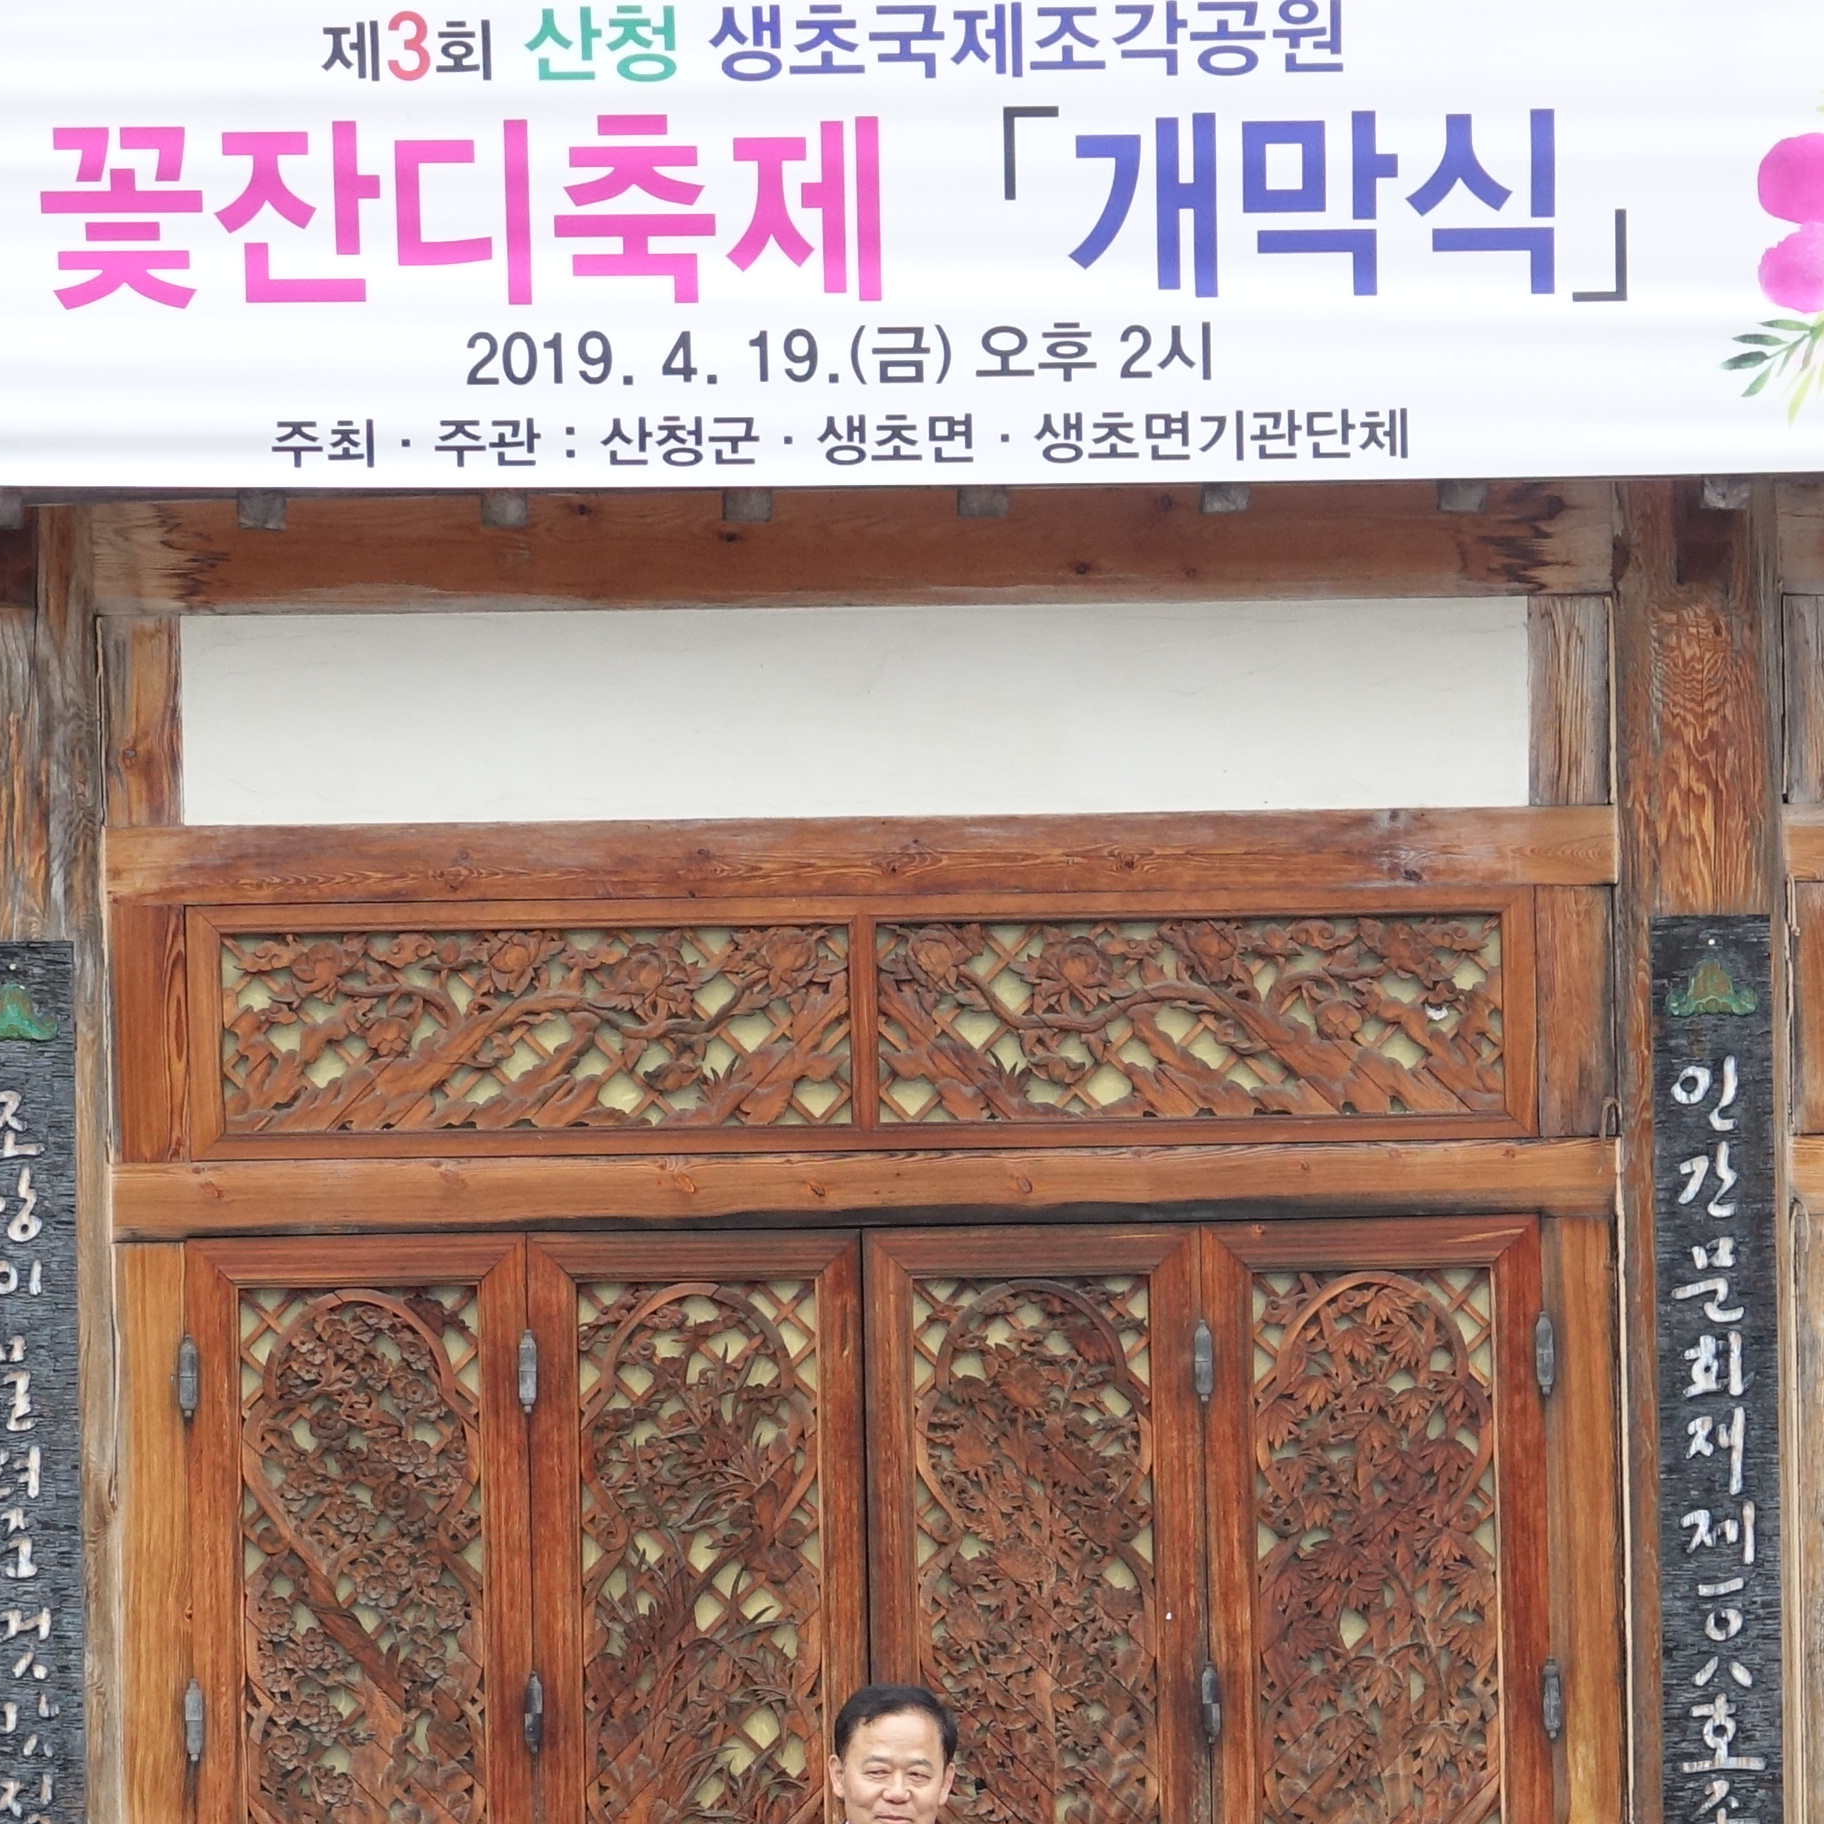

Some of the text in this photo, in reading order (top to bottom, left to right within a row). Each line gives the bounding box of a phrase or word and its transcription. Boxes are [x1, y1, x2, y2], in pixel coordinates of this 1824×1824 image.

[322, 0, 1344, 83] 제3회 산청 생초국제조각공원
[39, 113, 883, 311] 꽃잔디축제
[466, 330, 634, 386] 2019.
[661, 330, 718, 385] 4.
[975, 321, 1098, 383] 오후
[1119, 320, 1212, 381] 2시
[271, 418, 375, 469] 주최
[434, 417, 542, 468] 주관
[599, 415, 760, 468] 산청군
[816, 412, 974, 466] 생초면
[1033, 407, 1409, 464] 생초면기관단체
